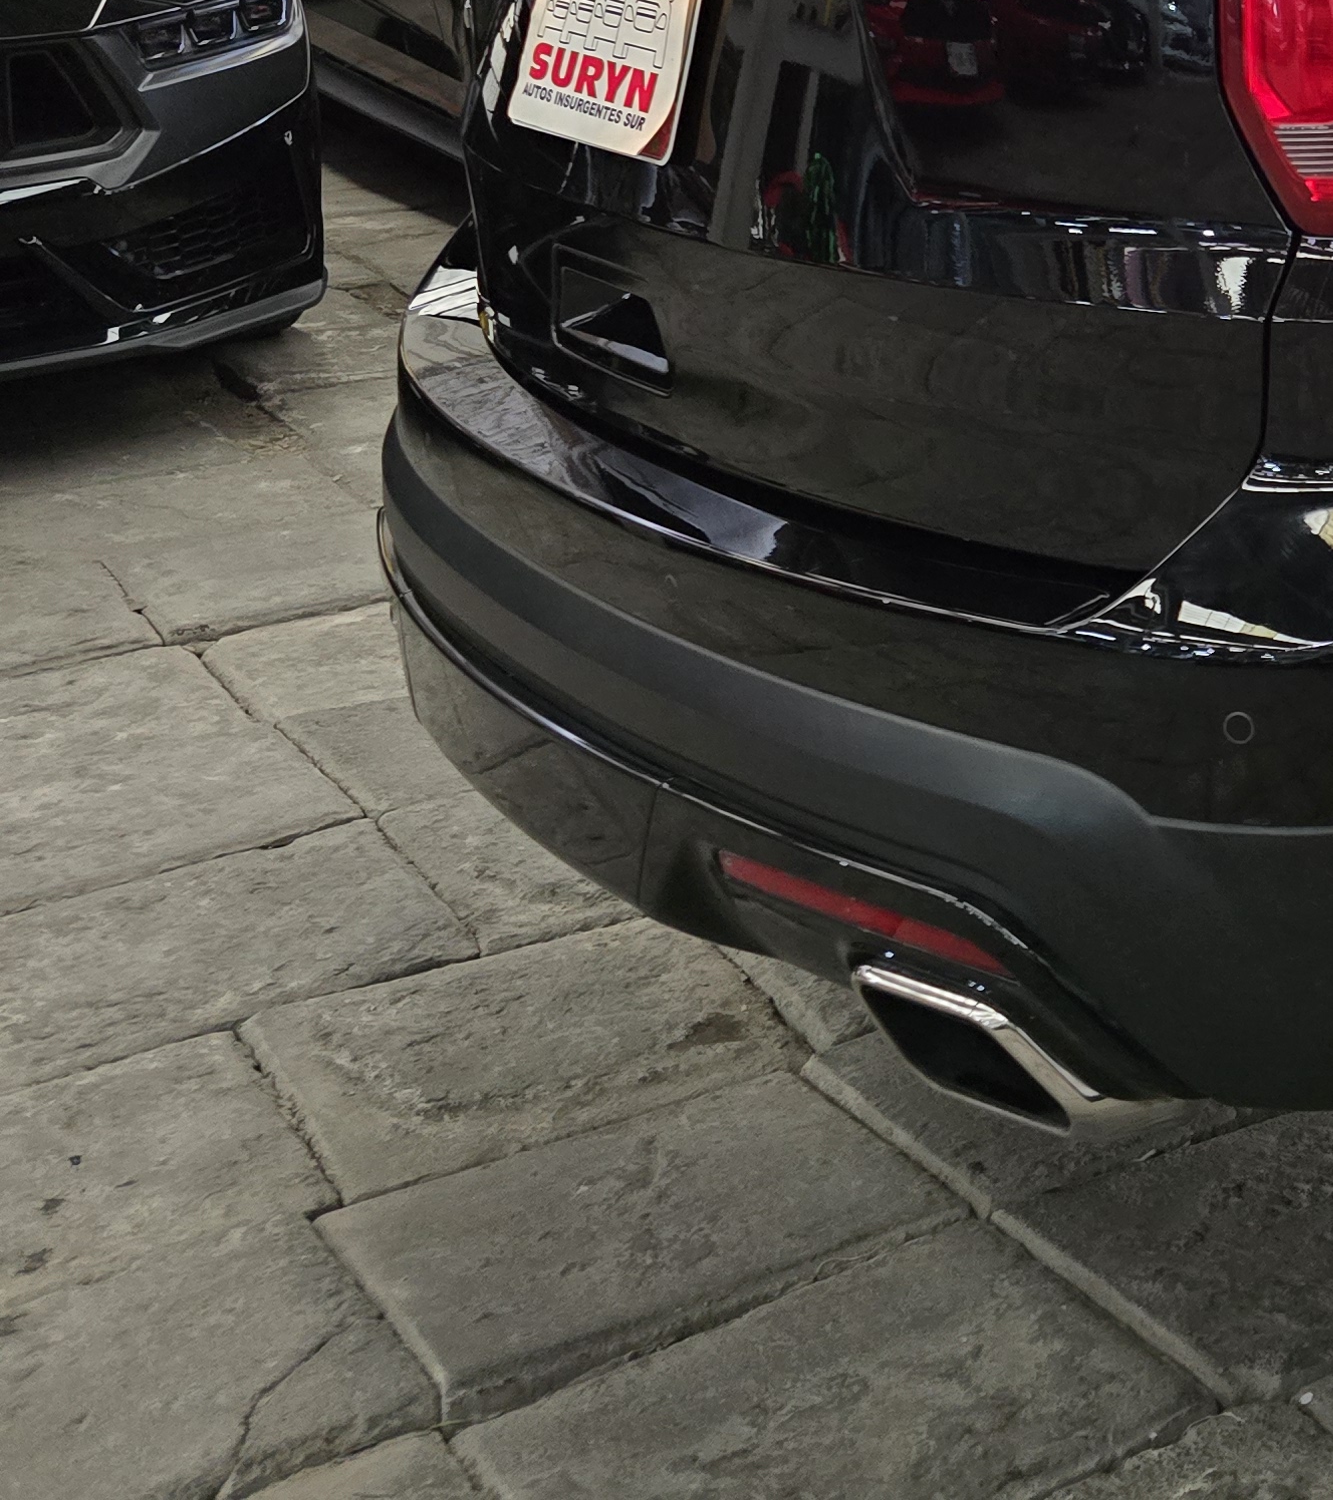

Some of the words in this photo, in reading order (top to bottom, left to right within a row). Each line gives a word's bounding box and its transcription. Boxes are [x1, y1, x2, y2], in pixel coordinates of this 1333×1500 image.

[522, 82, 553, 103] AUTOS
[553, 90, 622, 124] INSURGENTES
[623, 111, 646, 132] SUR
[529, 42, 659, 114] SURYN
